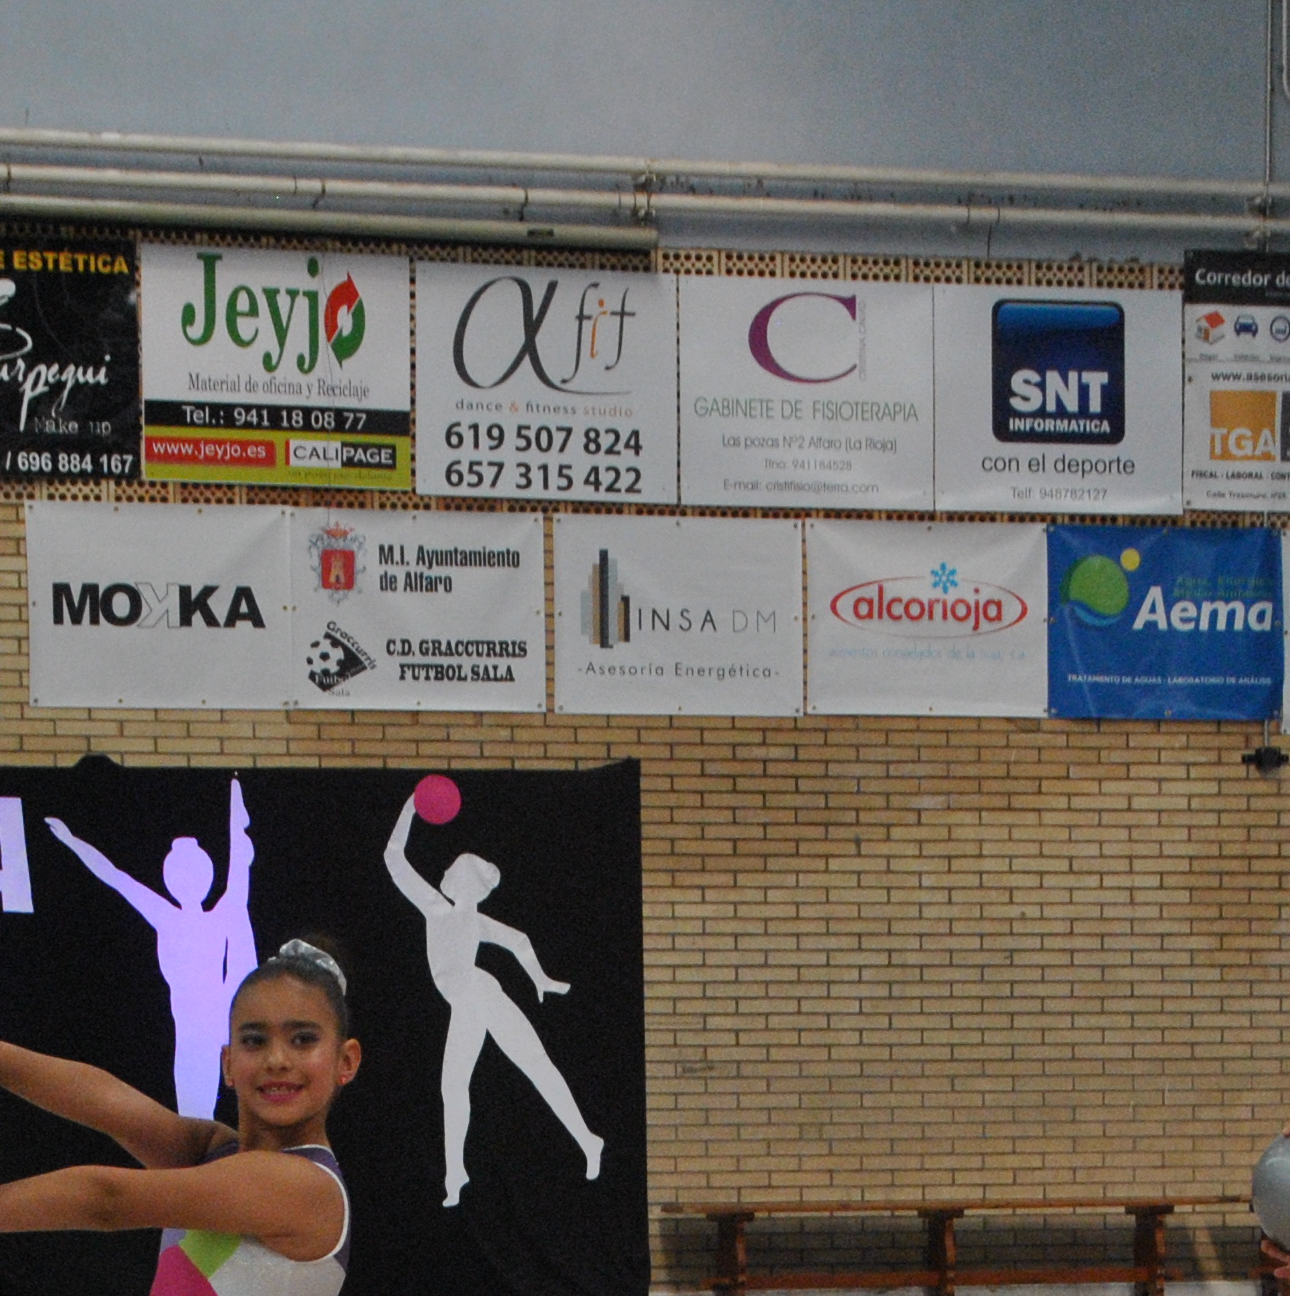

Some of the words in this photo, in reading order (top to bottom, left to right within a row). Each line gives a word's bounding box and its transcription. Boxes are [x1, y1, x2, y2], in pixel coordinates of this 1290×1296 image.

[1194, 267, 1271, 287] Corredor
[181, 252, 366, 375] Jeyjo
[188, 373, 242, 392] Material
[244, 376, 259, 392] de
[262, 376, 303, 395] oficina
[306, 383, 314, 398] y
[317, 378, 370, 401] Reciclaje
[1009, 368, 1109, 414] SNT
[233, 407, 271, 427] 941
[281, 409, 304, 428] 18
[311, 410, 335, 429] 08
[343, 412, 368, 430] 77
[455, 398, 503, 413] dance
[509, 401, 520, 413] &
[526, 400, 577, 415] fitness
[583, 402, 634, 417] studio
[694, 397, 775, 420] GABINETE
[781, 399, 803, 420] DE
[813, 400, 919, 422] FISIOTERAPIA
[1009, 416, 1111, 433] INFORMATICA
[152, 441, 267, 460] www.jeyjo.es
[445, 421, 505, 450] 619
[515, 424, 574, 453] 507
[583, 427, 643, 457] 824
[722, 434, 741, 448] Las
[745, 436, 780, 449] pozas
[808, 437, 842, 450] Alfaro
[1209, 426, 1277, 457] TGA
[17, 451, 53, 472] 696
[59, 452, 93, 473] 884
[99, 453, 134, 474] 167
[293, 445, 393, 465] CALIPAGE
[981, 455, 1020, 473] con
[1027, 453, 1046, 474] el
[1053, 454, 1136, 479] deporte
[445, 459, 505, 489] 657
[515, 461, 574, 492] 315
[583, 465, 643, 494] 422
[378, 544, 410, 566] M.I.
[415, 544, 521, 570] Ayuntamiento
[379, 570, 398, 592] de
[403, 572, 453, 593] Alfaro
[852, 583, 1003, 632] alcorioja
[1132, 585, 1274, 632] Aema
[638, 607, 717, 632] INSA
[732, 609, 777, 634] DM
[326, 620, 377, 671] Graccurris
[385, 638, 415, 657] C.D.
[418, 639, 528, 659] GRACCURRIS
[398, 663, 468, 681] FUTBOL
[470, 664, 516, 683] SALA
